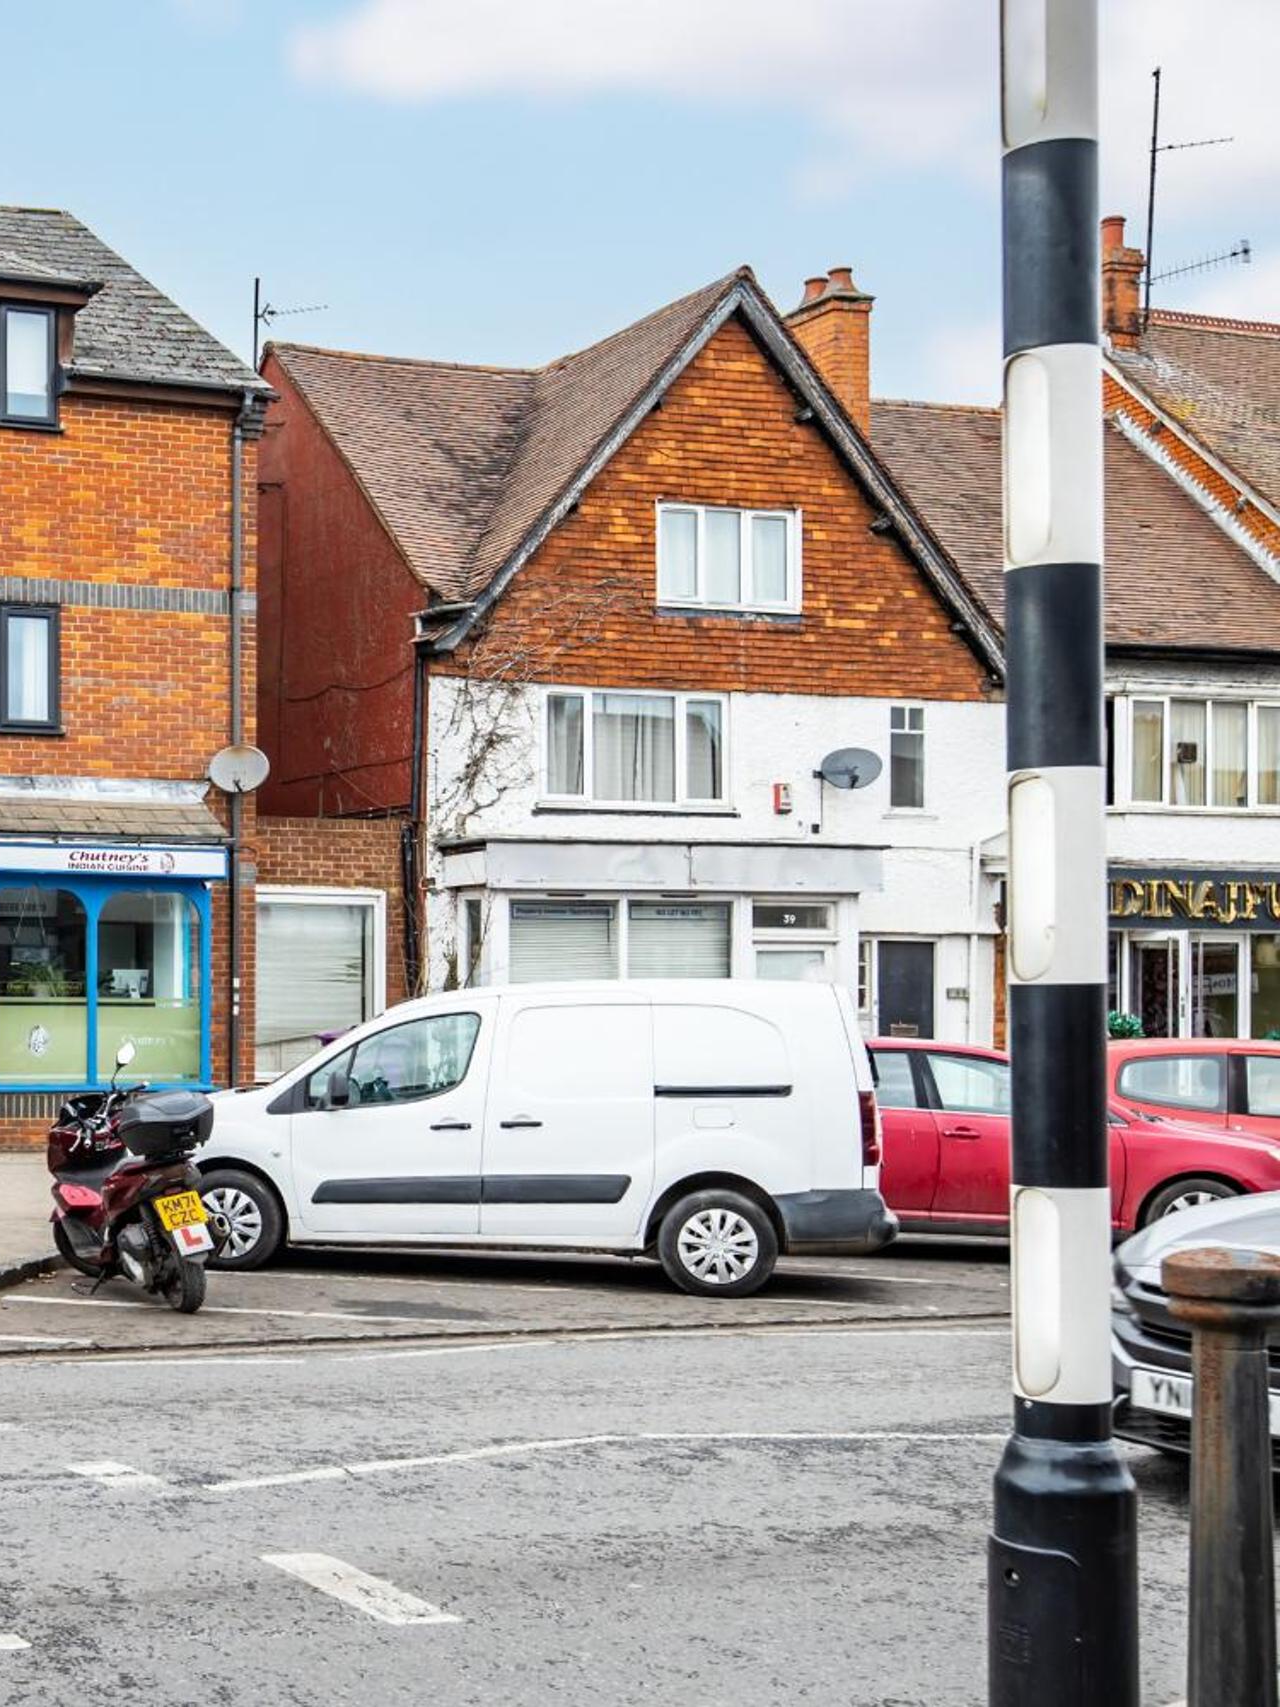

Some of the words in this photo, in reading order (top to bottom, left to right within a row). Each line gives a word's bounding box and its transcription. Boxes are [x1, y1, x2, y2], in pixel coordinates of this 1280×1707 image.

[69, 851, 150, 866] Chutney's
[68, 862, 105, 870] INDIAN
[107, 863, 149, 872] CUISINE
[783, 913, 797, 925] 39
[161, 1195, 197, 1213] KM71
[169, 1208, 200, 1226] CZC
[180, 1228, 203, 1247] L
